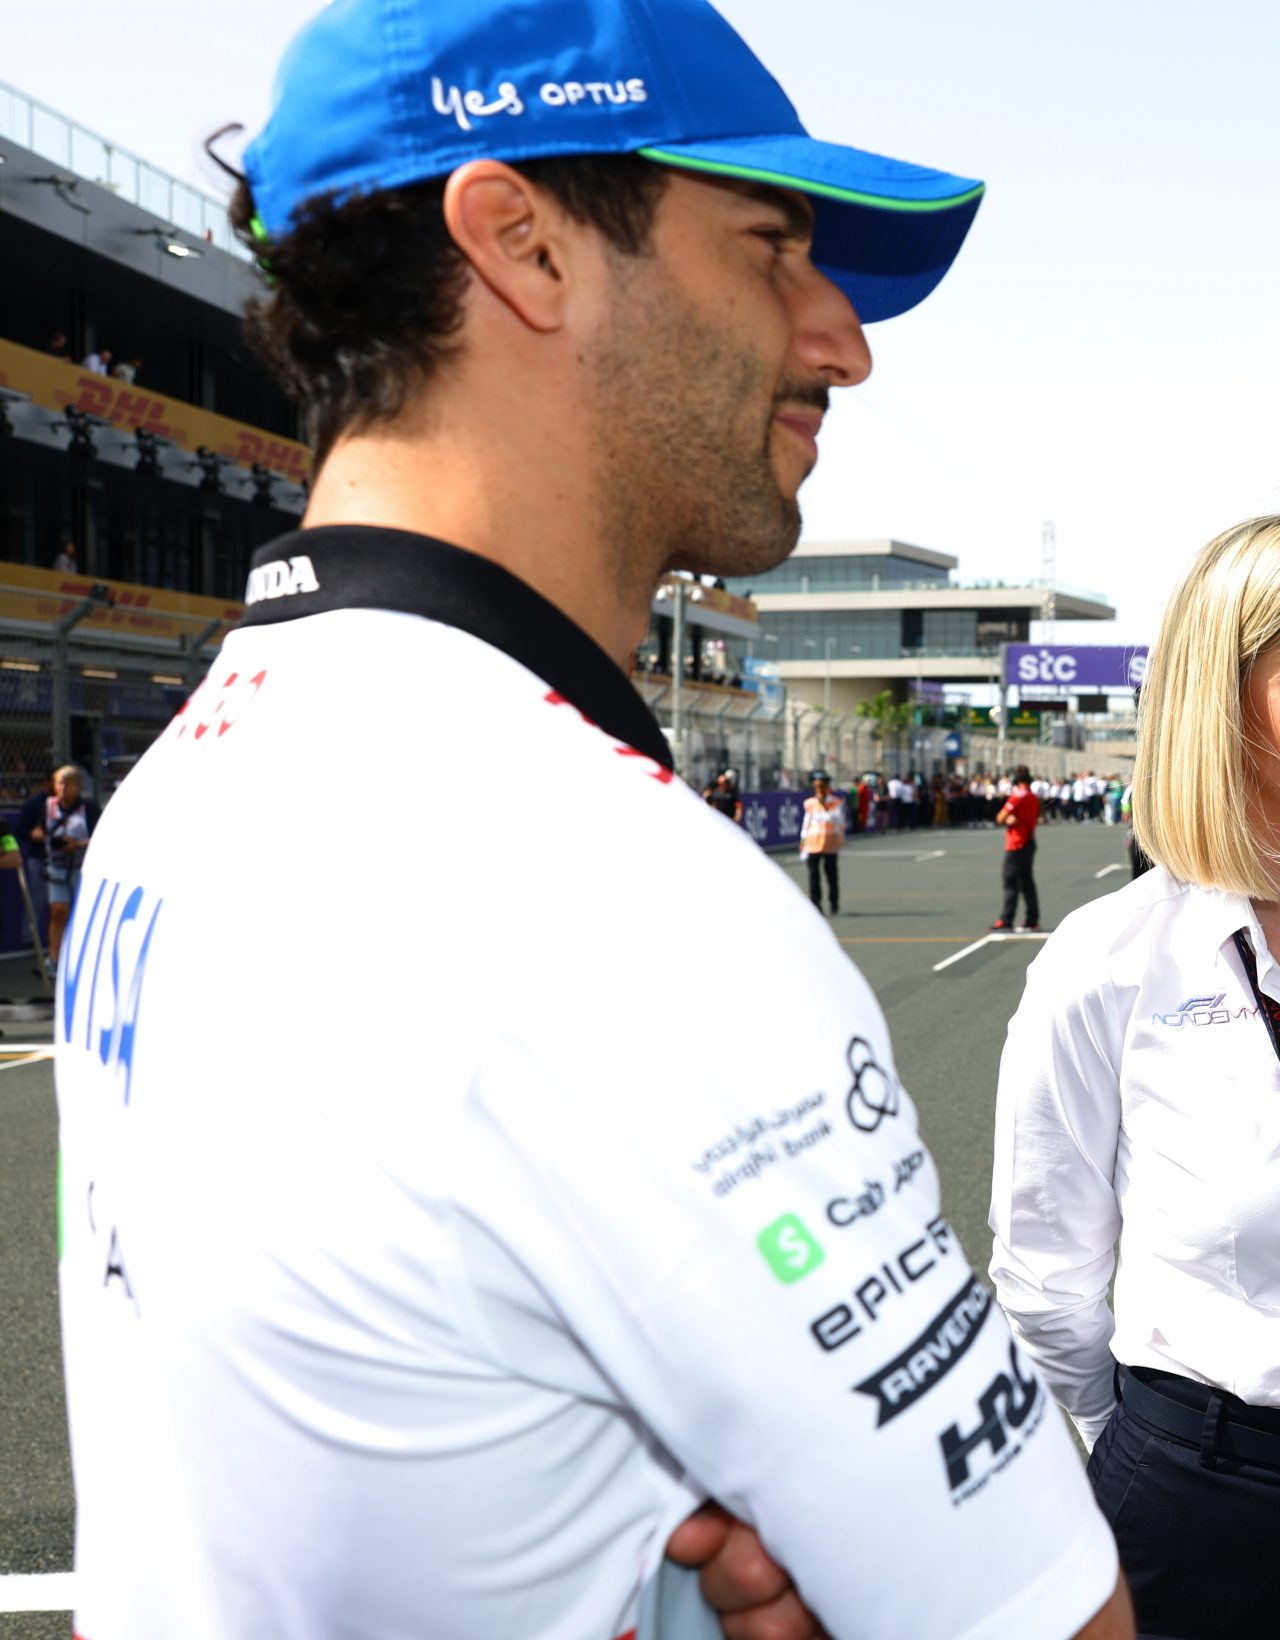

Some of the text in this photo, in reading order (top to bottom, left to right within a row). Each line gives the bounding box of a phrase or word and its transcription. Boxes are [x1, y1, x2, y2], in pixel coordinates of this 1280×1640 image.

[540, 78, 647, 106] OPTUS
[74, 375, 172, 439] DHL
[1018, 650, 1077, 681] stc
[1152, 1007, 1259, 1027] ACADEMY
